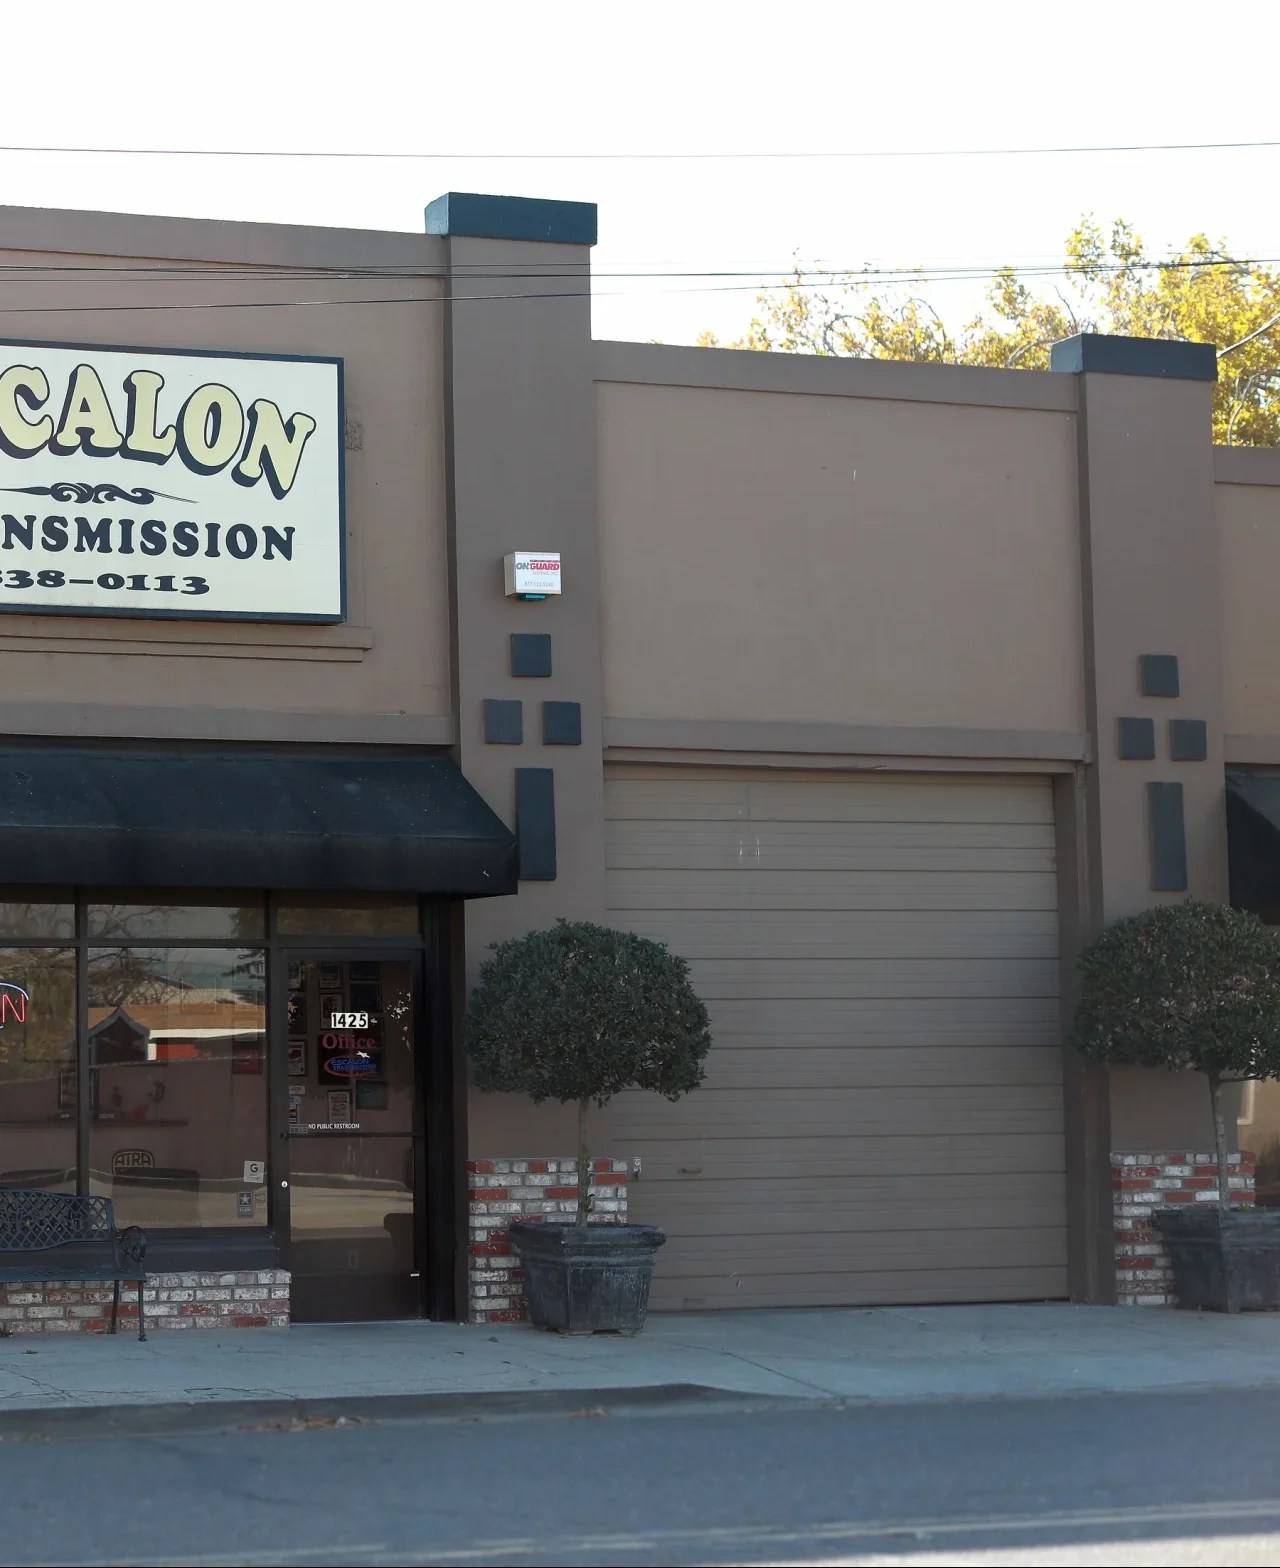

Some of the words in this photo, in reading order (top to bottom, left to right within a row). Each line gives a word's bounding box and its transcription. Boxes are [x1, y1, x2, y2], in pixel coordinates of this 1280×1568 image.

[332, 1013, 367, 1028] 1425
[322, 1033, 376, 1049] Office
[114, 1152, 151, 1166] ATRA
